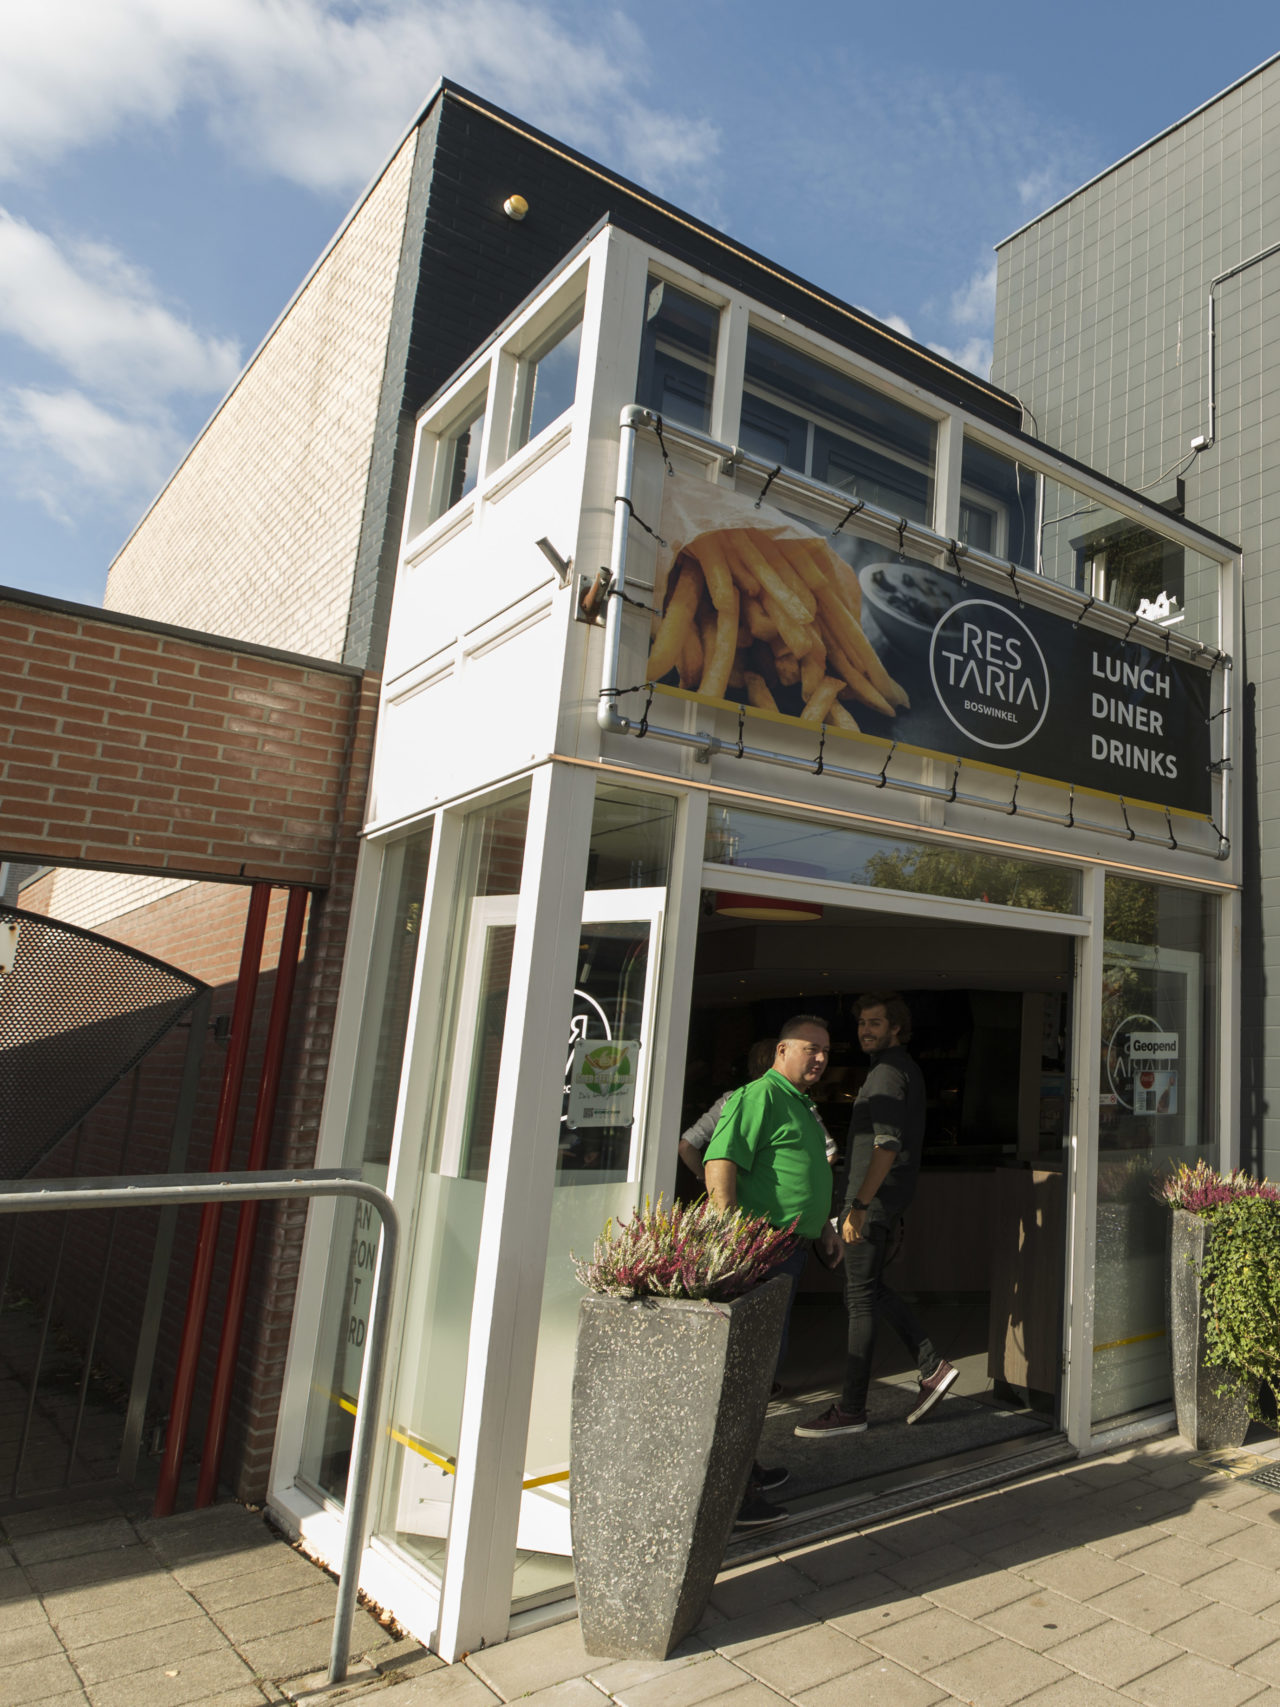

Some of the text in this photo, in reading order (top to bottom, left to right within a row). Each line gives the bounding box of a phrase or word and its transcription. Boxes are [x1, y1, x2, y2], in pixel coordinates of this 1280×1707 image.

[963, 622, 1022, 670] RES
[941, 650, 1039, 711] TARIA
[1092, 651, 1170, 699] LUNCH
[964, 700, 1018, 723] BOSWINKEL
[1091, 692, 1164, 736] DINER
[1091, 733, 1178, 779] DRINKS
[1133, 1040, 1177, 1055] Geopend
